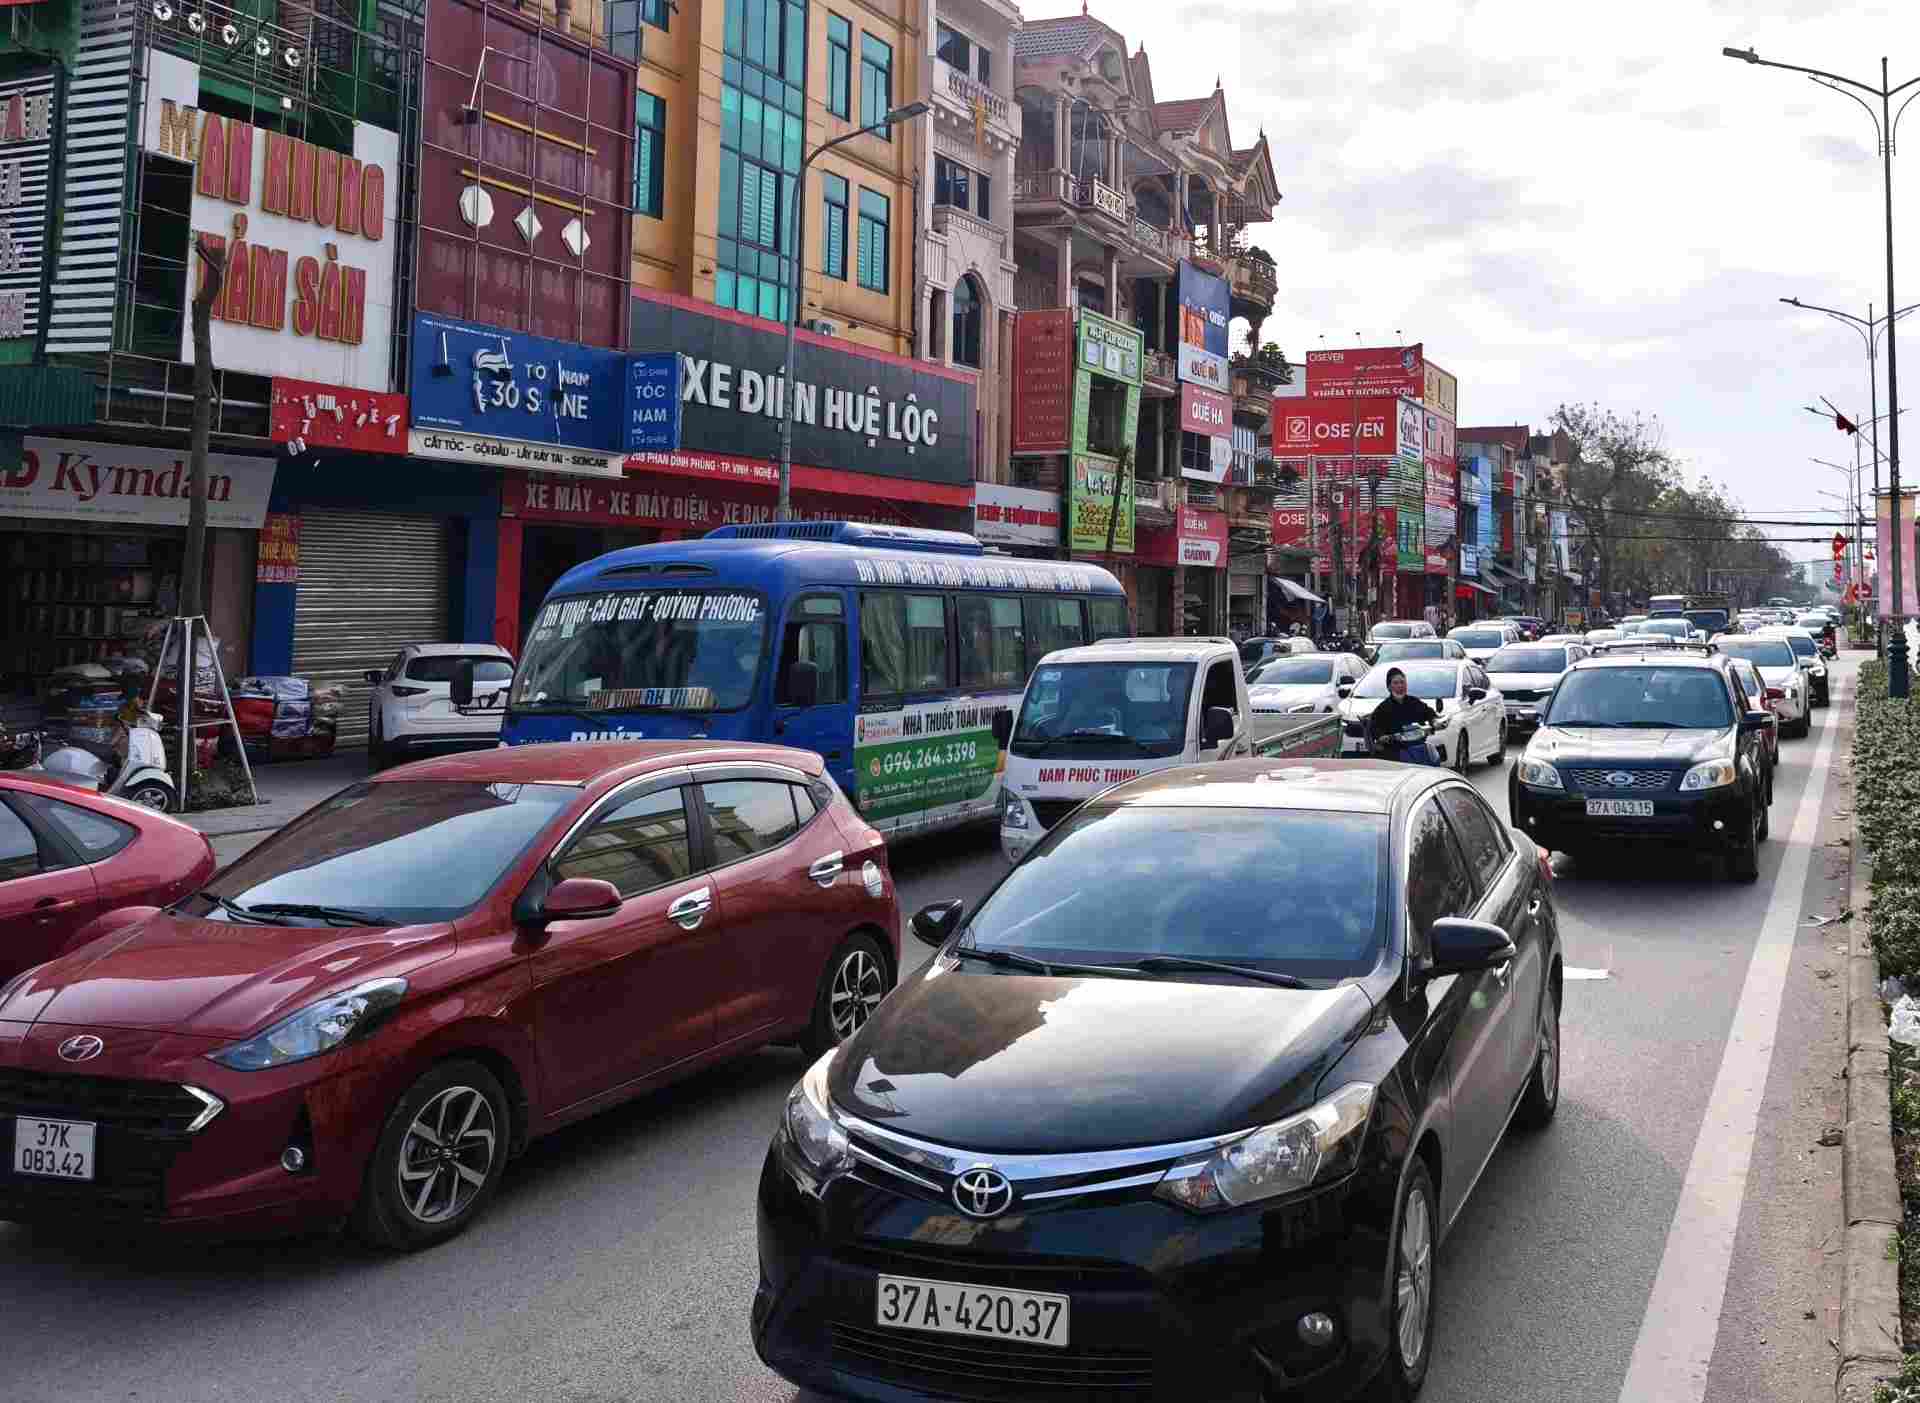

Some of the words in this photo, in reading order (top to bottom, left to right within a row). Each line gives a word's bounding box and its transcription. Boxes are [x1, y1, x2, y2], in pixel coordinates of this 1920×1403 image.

[632, 408, 667, 422] NAM
[682, 356, 731, 409] XE
[824, 384, 880, 448] HUỆ
[887, 393, 939, 455] LỘC
[526, 483, 548, 509] XE
[554, 482, 592, 513] MÁY
[609, 490, 630, 516] XE
[635, 489, 669, 519] MÁY
[925, 704, 953, 733] THUỐC
[1038, 768, 1065, 782] NAM
[1068, 764, 1100, 782] PHÚC
[37, 1123, 71, 1148] 37K
[22, 1148, 84, 1176] 083.42
[882, 1283, 1063, 1340] 37A-420.37
